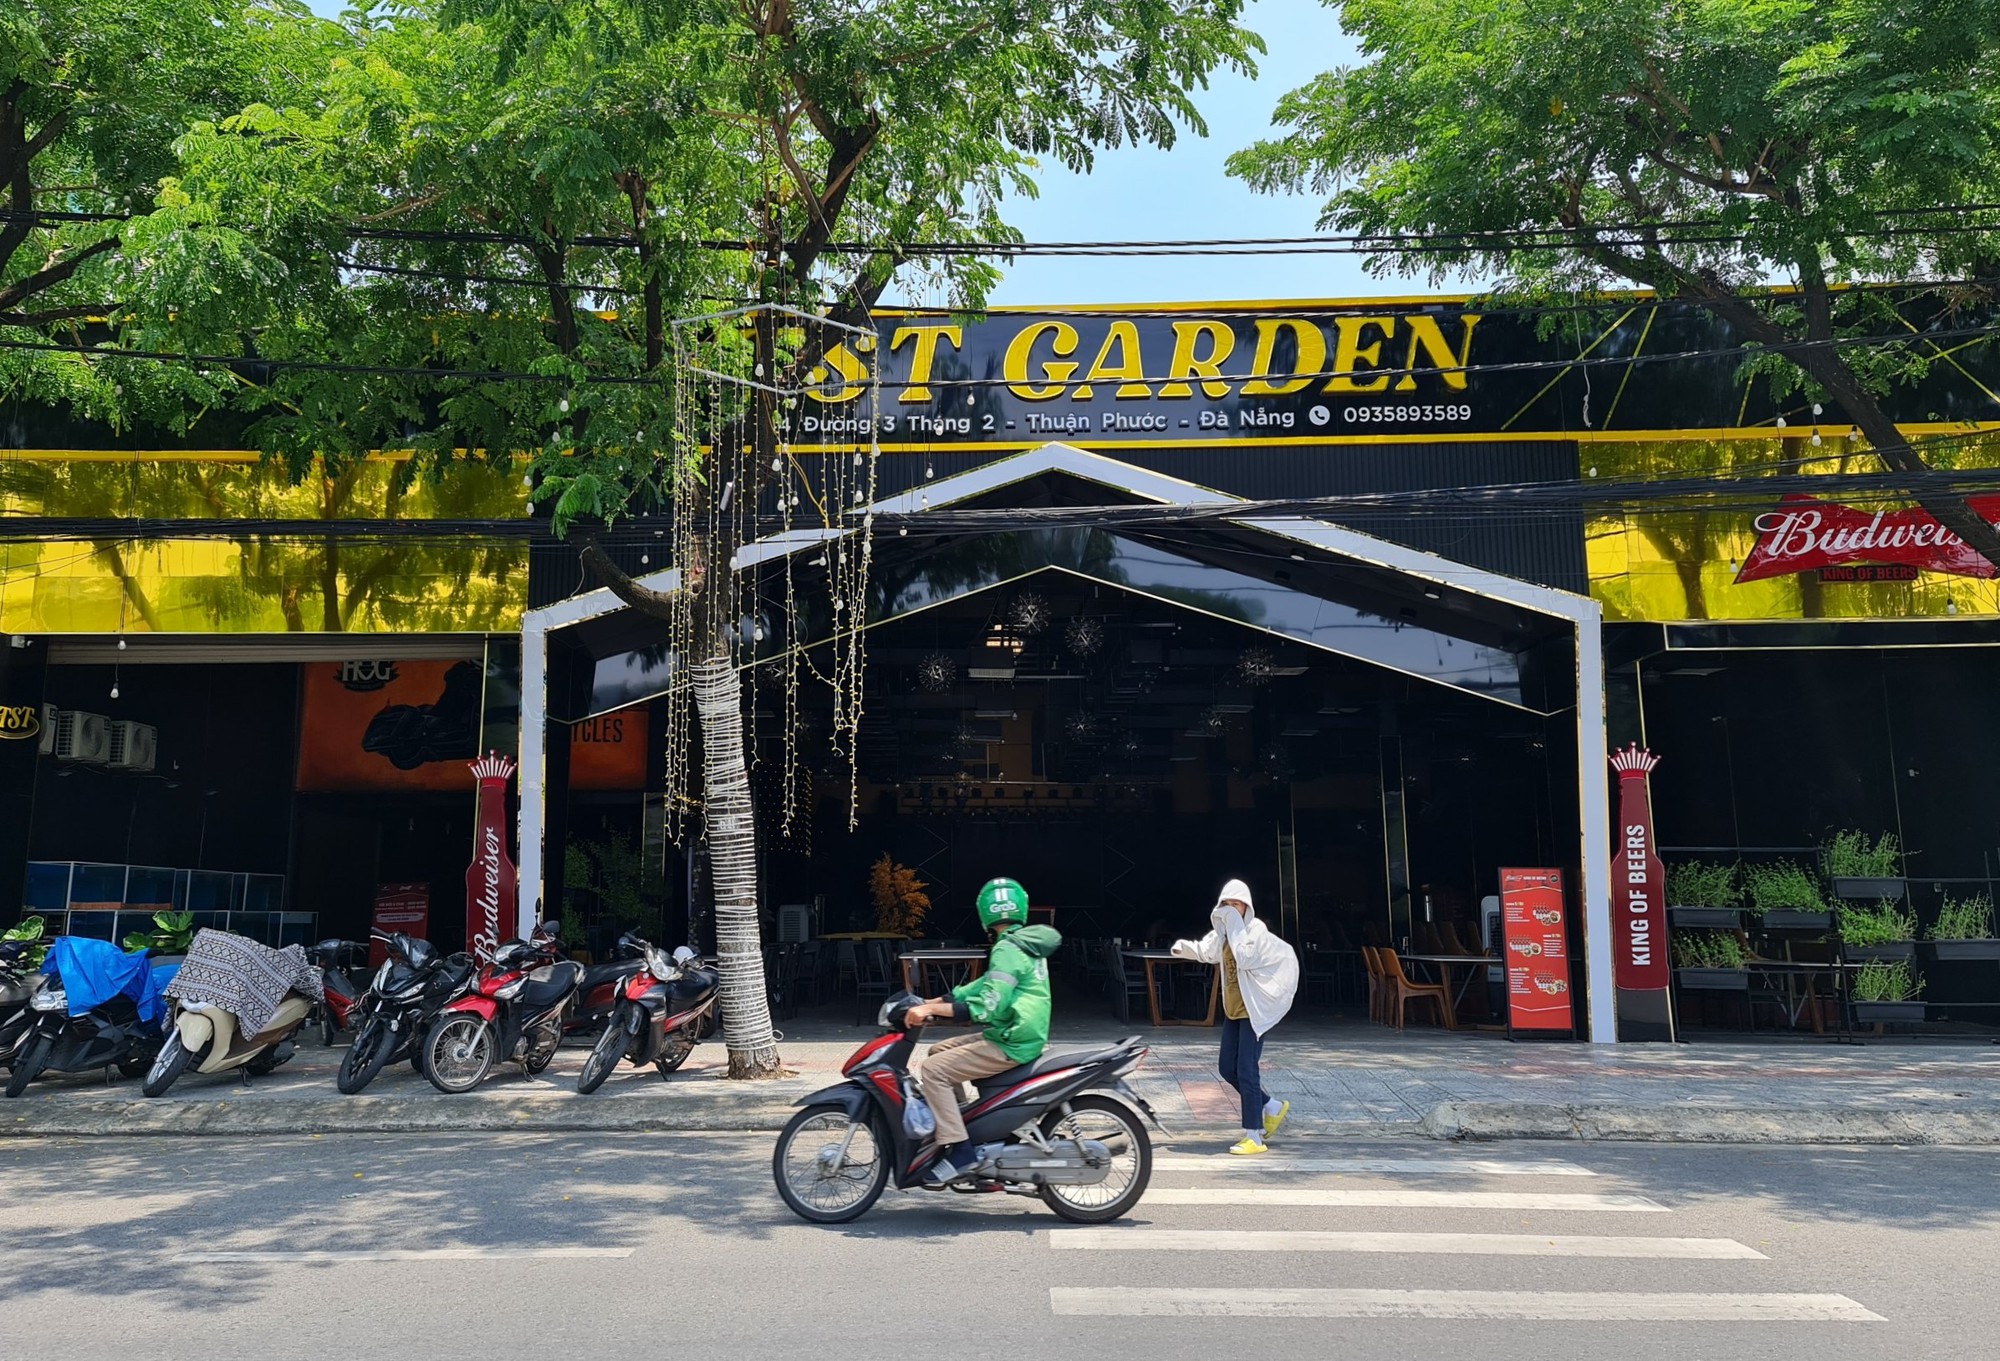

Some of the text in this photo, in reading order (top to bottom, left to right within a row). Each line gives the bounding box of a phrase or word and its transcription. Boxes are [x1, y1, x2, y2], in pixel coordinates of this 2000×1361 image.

[1003, 314, 1483, 399] GARDEN
[883, 415, 896, 432] 3
[982, 413, 995, 431] 2
[1027, 412, 1090, 433] Thuận
[1103, 410, 1167, 430] Phước
[1200, 409, 1229, 427] Đà
[1343, 404, 1472, 423] 0935893589
[1823, 566, 1917, 582] KING OF BEERS
[989, 900, 1018, 914] Grab
[1626, 824, 1651, 966] KING OF BEERS
